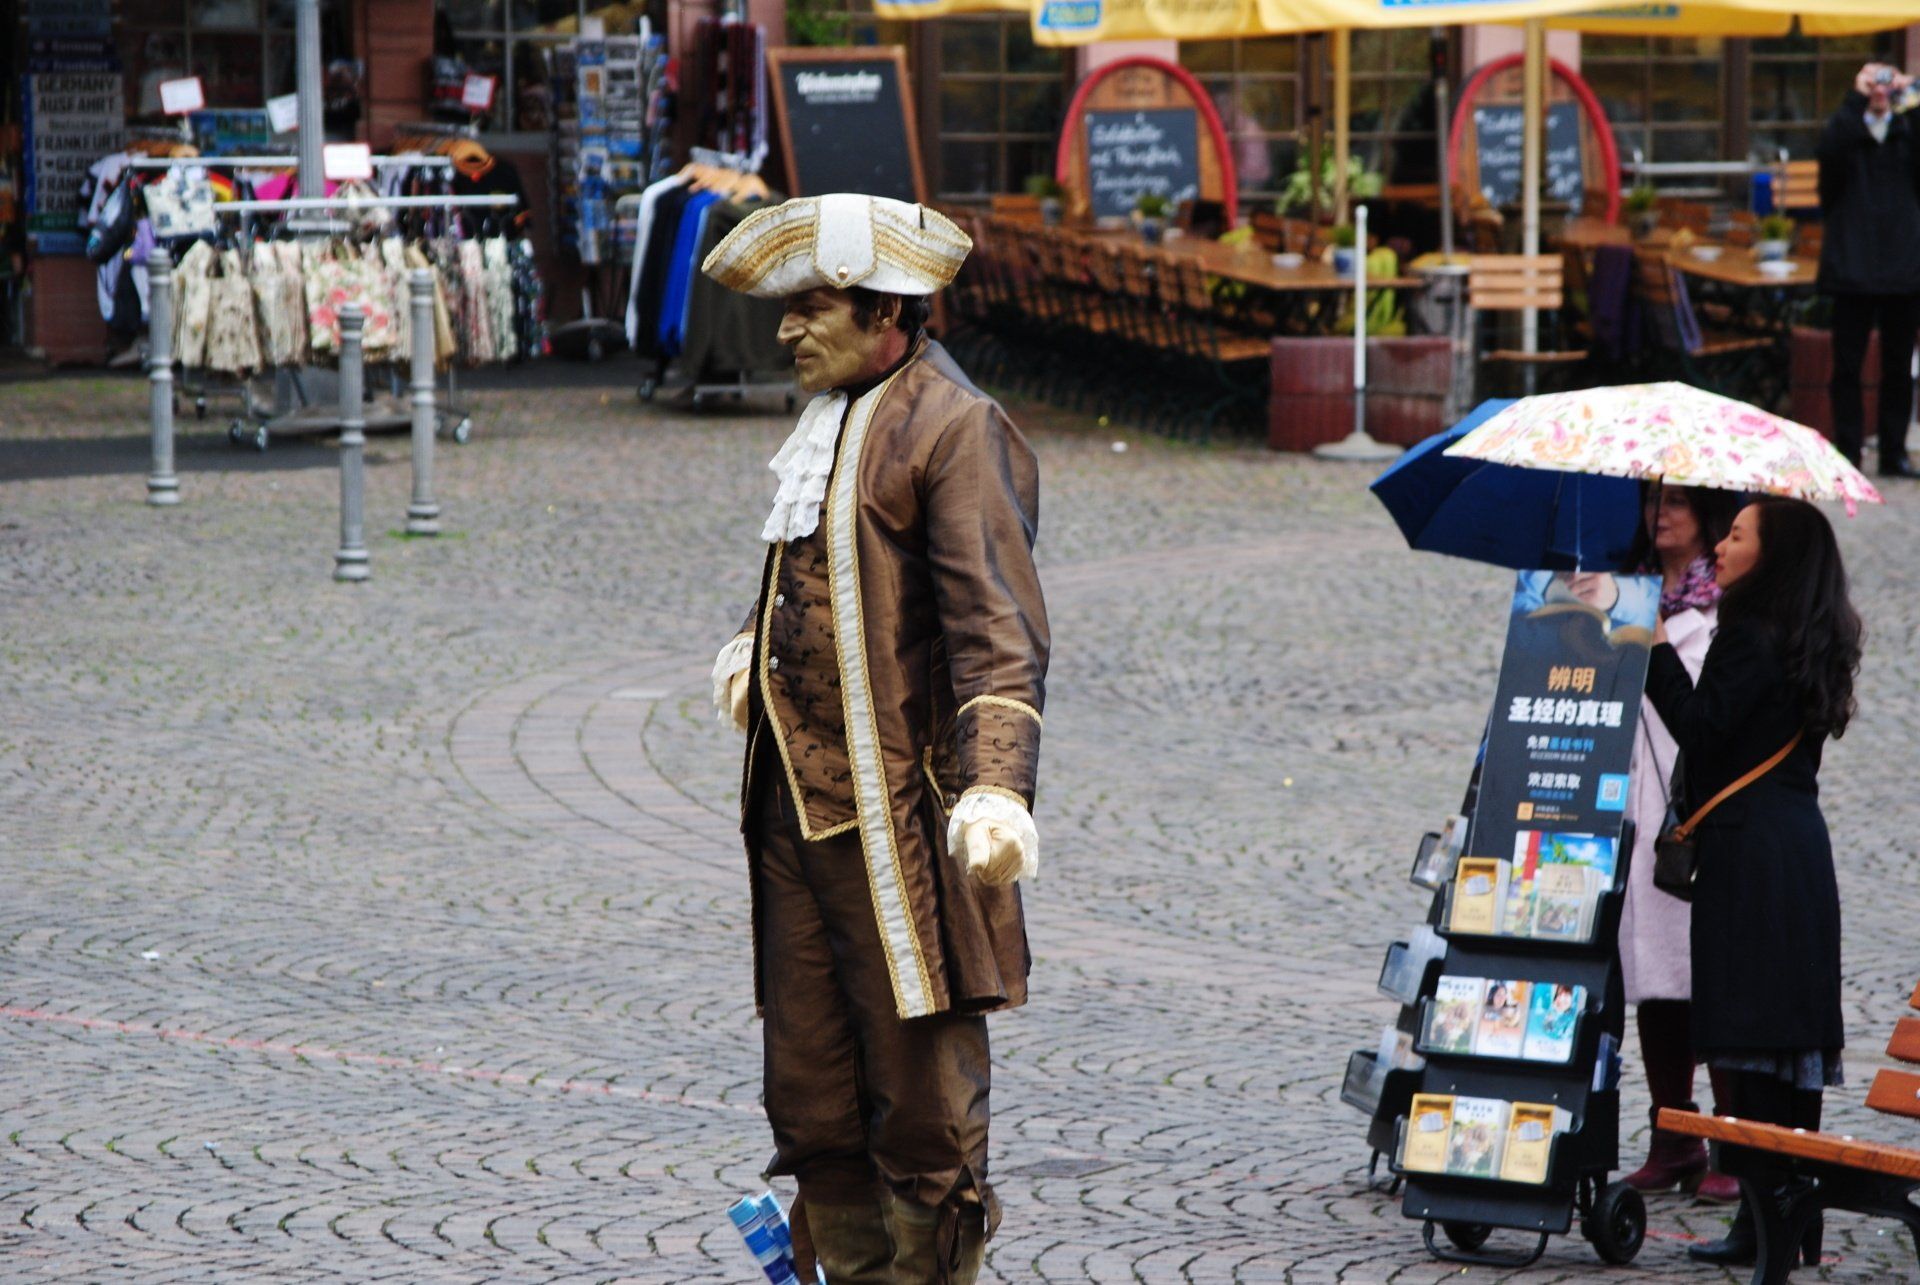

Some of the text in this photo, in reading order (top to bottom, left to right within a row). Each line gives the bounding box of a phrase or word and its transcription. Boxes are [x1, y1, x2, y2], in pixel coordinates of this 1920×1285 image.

[37, 74, 115, 92] GERMANY
[39, 95, 116, 113] AUSFAHRT
[35, 133, 121, 151] FRANKFURT
[1508, 696, 1624, 727] 圣经的真理
